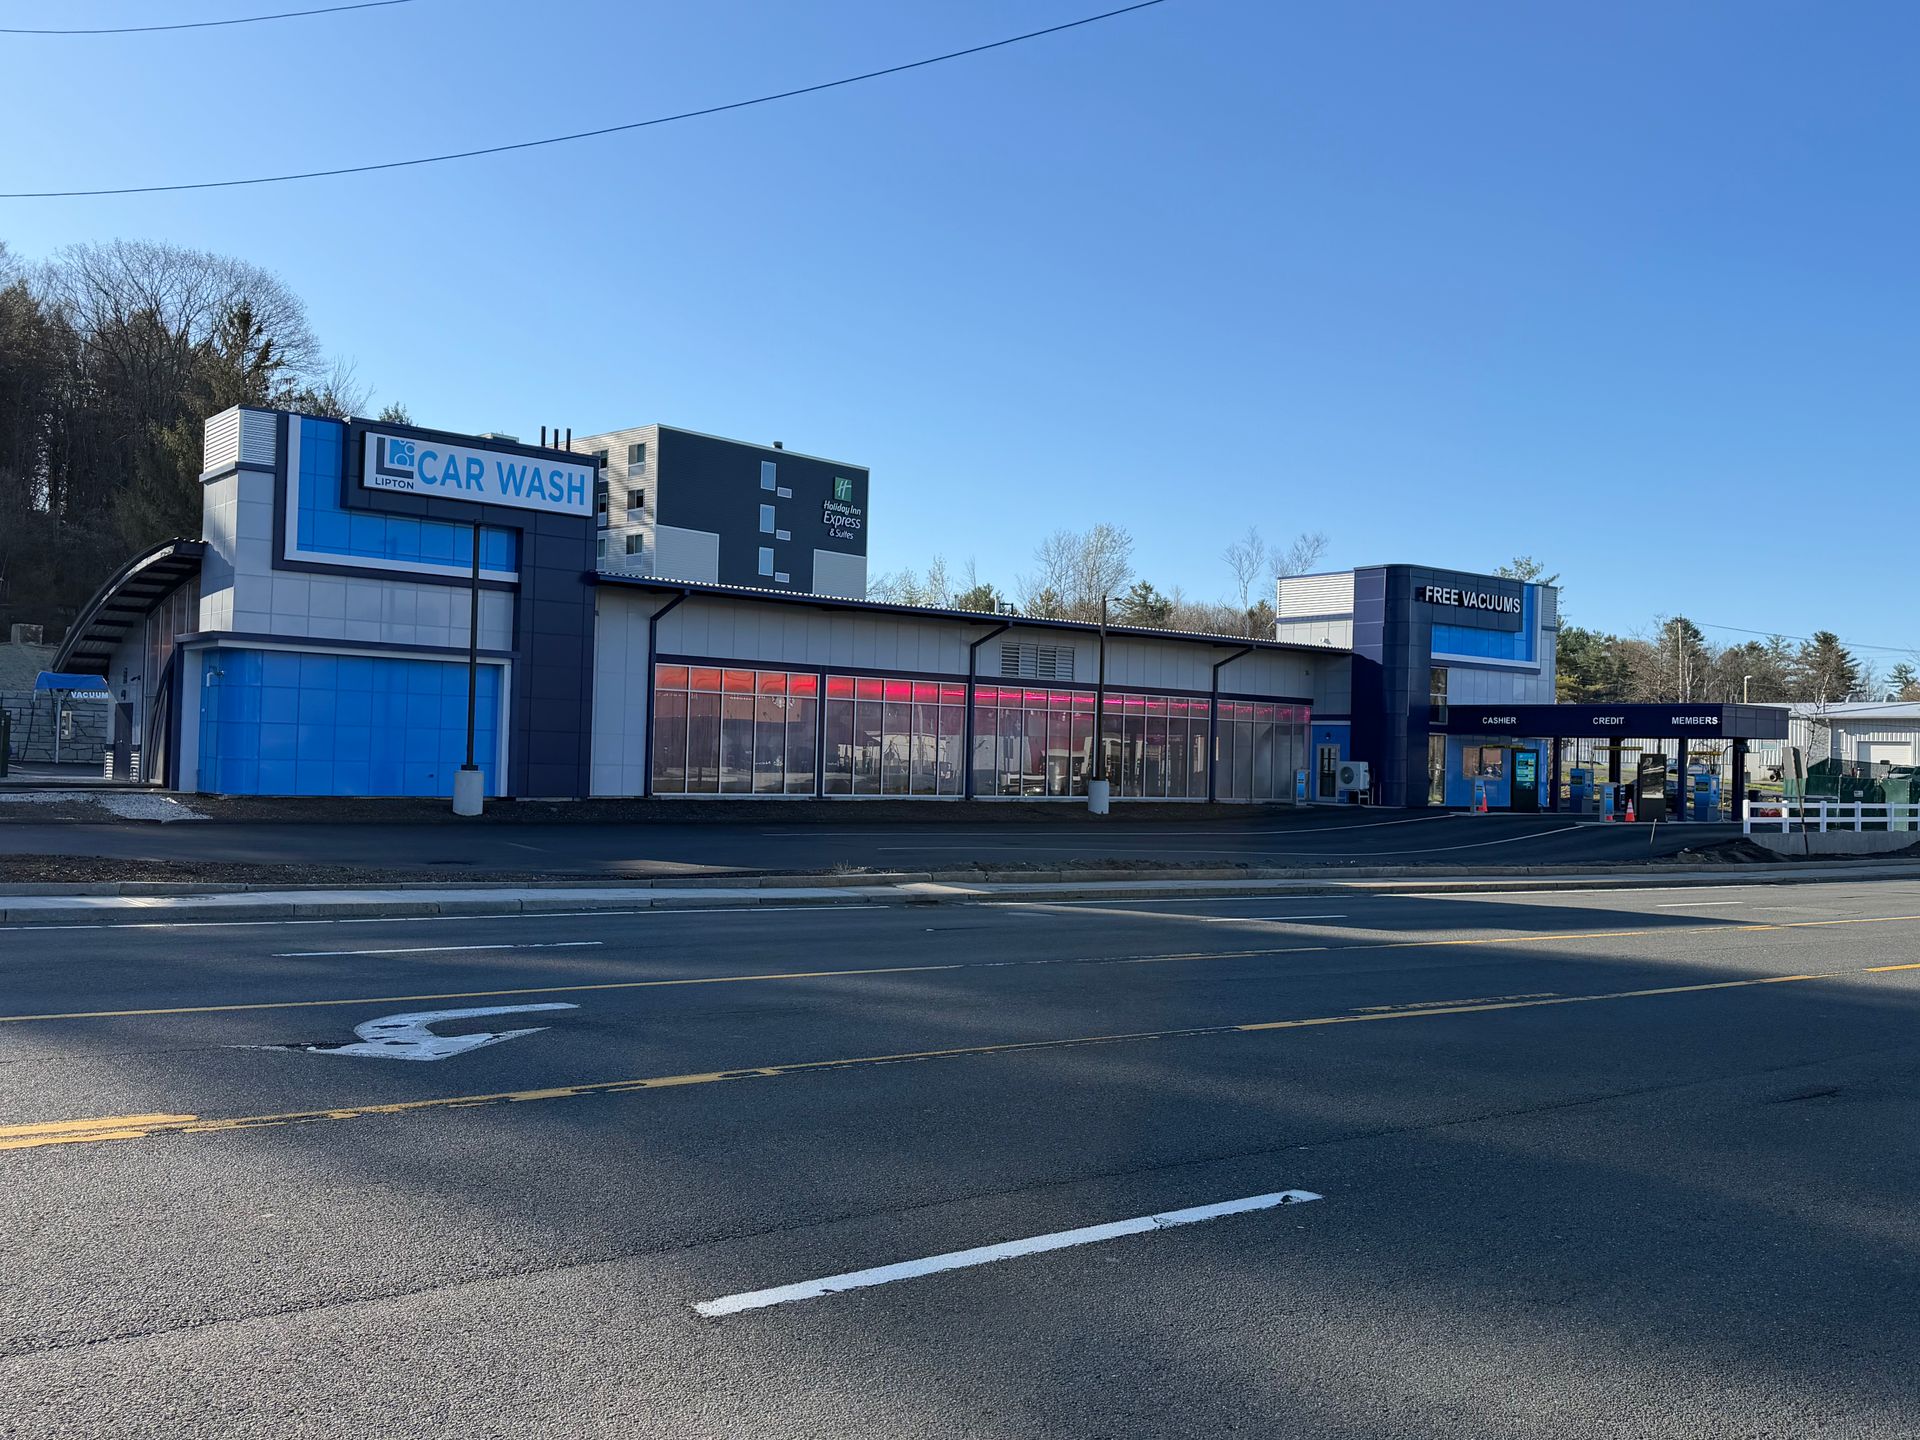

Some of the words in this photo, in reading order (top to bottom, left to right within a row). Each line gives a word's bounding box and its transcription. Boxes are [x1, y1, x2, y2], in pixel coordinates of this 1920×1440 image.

[375, 477, 414, 490] LIPTON
[417, 450, 485, 492] CAR
[496, 461, 585, 506] WASH
[823, 500, 850, 515] Holiday
[850, 505, 861, 515] Inn
[823, 511, 861, 528] Express
[829, 528, 835, 537] &
[835, 529, 854, 539] Suites
[1425, 585, 1459, 606] FREE
[1462, 590, 1521, 613] VACUUMS
[70, 691, 109, 699] VACUUM
[1482, 716, 1517, 725] CASHIER
[1592, 716, 1625, 725] CREDIT
[1671, 716, 1719, 725] MEMBERS
